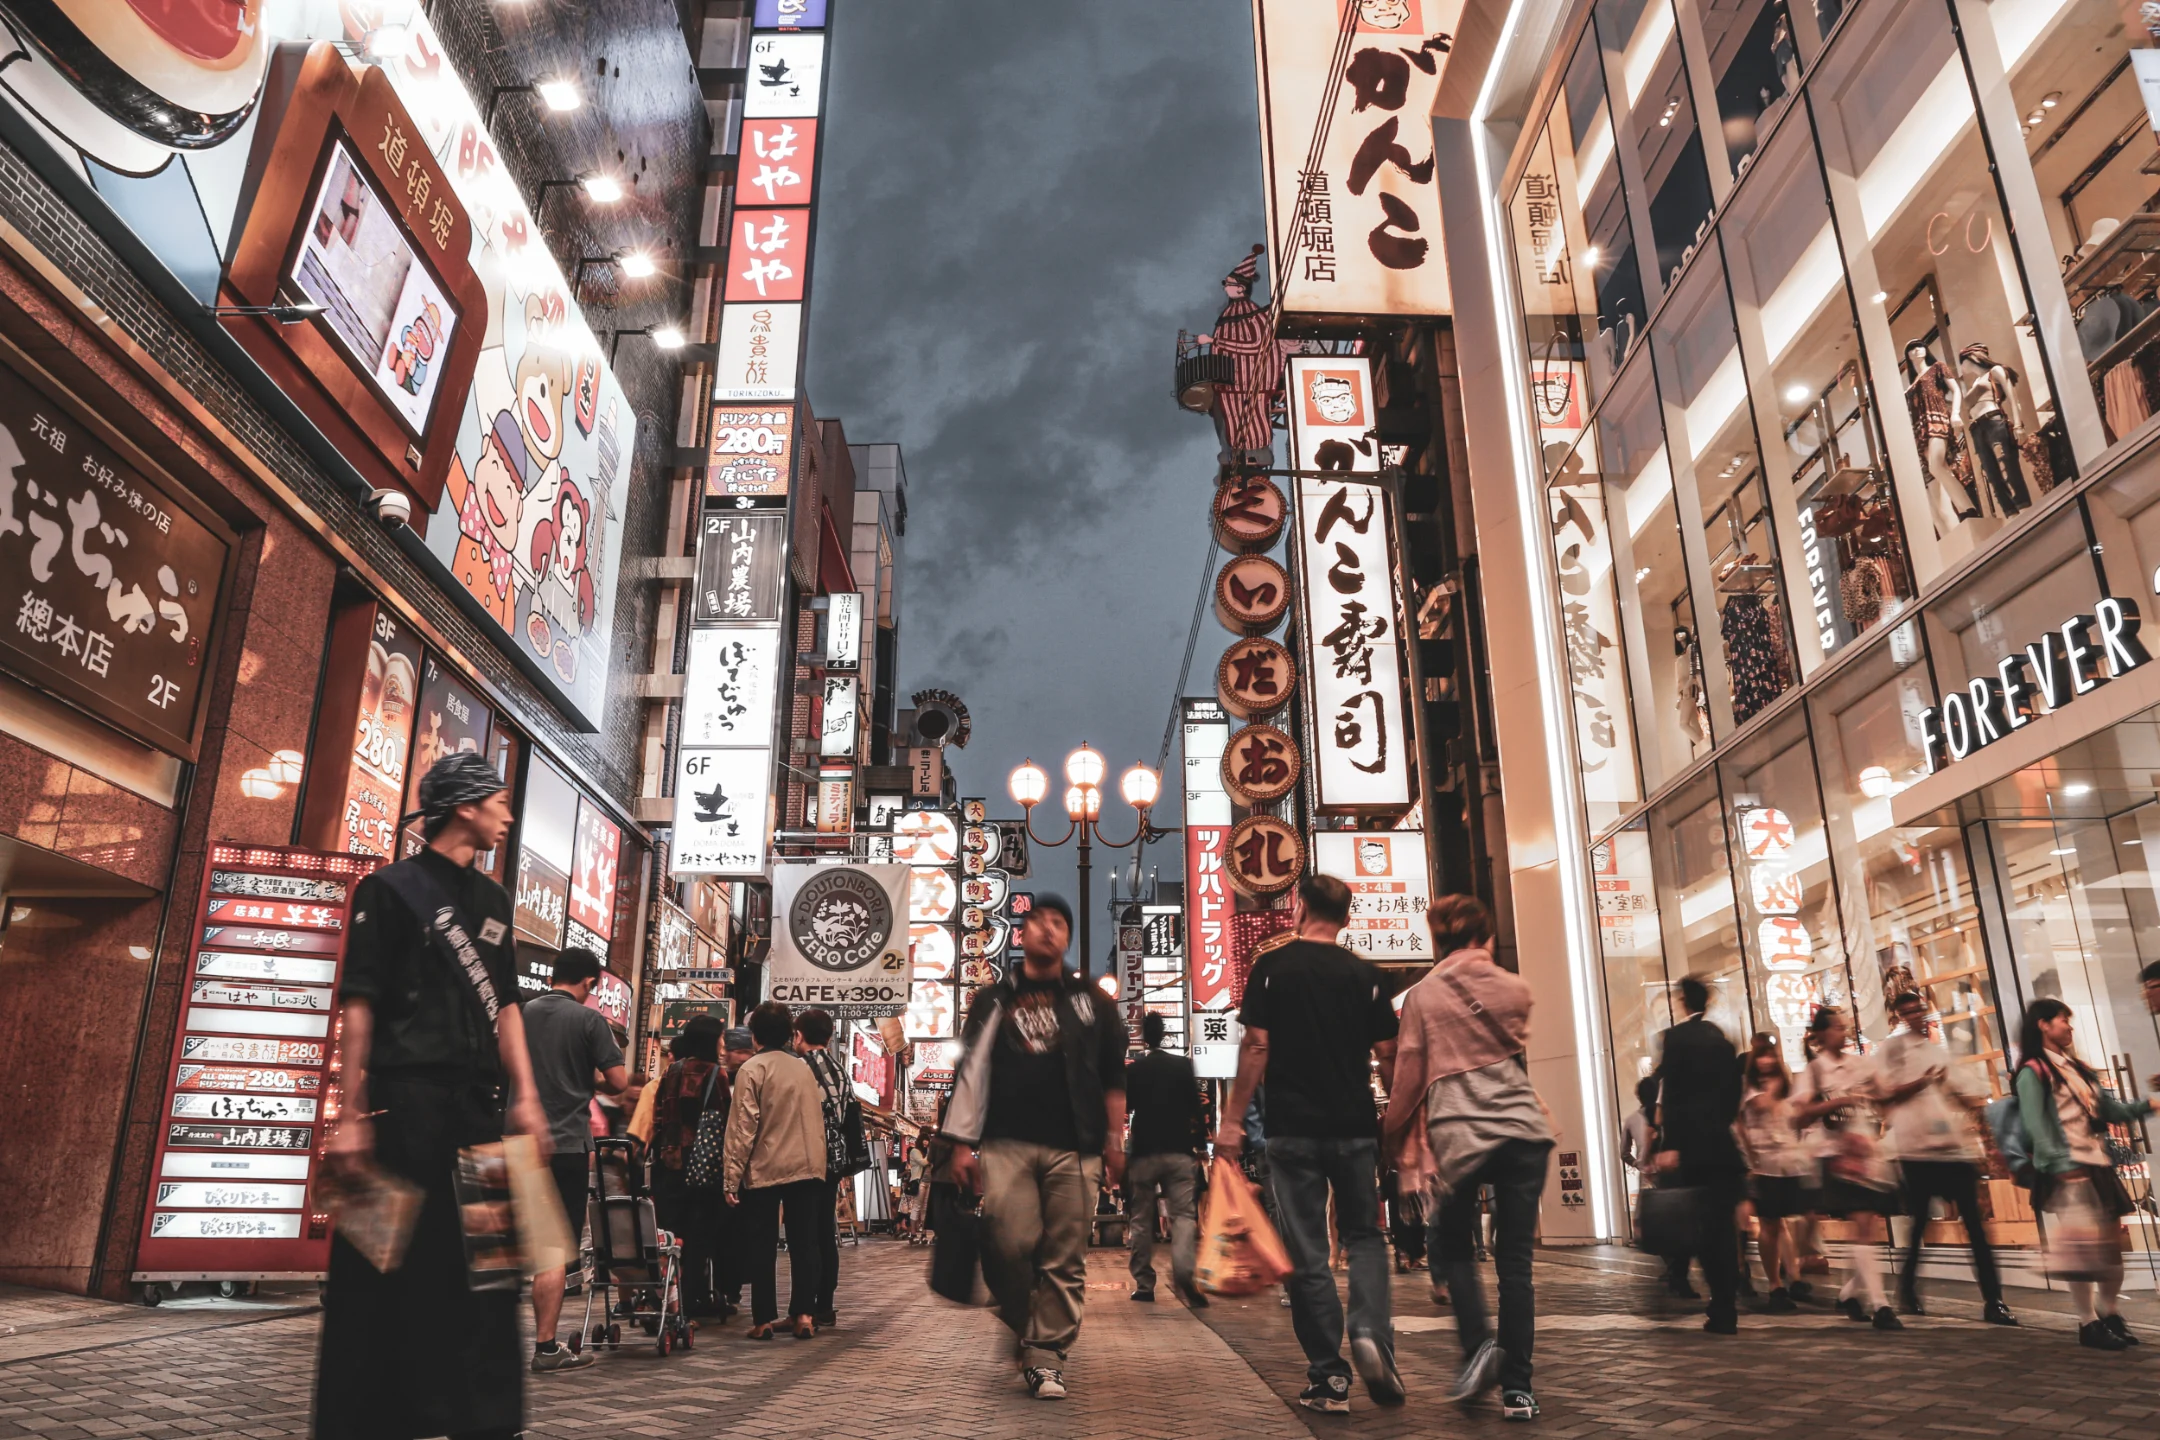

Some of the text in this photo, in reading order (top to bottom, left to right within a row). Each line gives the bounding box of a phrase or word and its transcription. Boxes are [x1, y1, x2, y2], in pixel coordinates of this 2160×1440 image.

[755, 40, 776, 53] 6F
[752, 123, 801, 200] はや
[378, 112, 455, 251] 道頓堀
[1297, 170, 1336, 283] 道頓堀店
[742, 215, 793, 296] はや
[745, 309, 772, 385] 鳥貴族
[30, 413, 67, 454] 元祖
[715, 427, 787, 455] 280円
[82, 454, 172, 534] お好み焼の店
[736, 496, 755, 509] 3F
[707, 518, 731, 534] 2F
[724, 519, 757, 617] 山内農場
[1797, 506, 1836, 651] FOREVER
[375, 612, 396, 643] 3F
[427, 660, 438, 682] 7F
[147, 674, 181, 709] 2F
[1917, 597, 2137, 775] FOREVER
[445, 693, 471, 726] 居食屋
[1186, 725, 1200, 734] 5F
[686, 756, 711, 775] 6F
[1187, 759, 1200, 767] 4F
[1187, 793, 1201, 801] 3F
[520, 851, 532, 873] 2F
[517, 874, 563, 930] 山内農場
[798, 875, 885, 913] DOUTONBORI
[1197, 830, 1227, 986] ツルハドラッグ
[798, 931, 883, 966] ZERO Cafe
[883, 953, 905, 970] 2F
[772, 985, 835, 1001] CAFE
[1204, 1018, 1227, 1041] 薬
[200, 1072, 247, 1081] ALL DRINK
[171, 1126, 189, 1136] 2F
[222, 1127, 292, 1147] 山内農場
[205, 1187, 280, 1206] びっくりドンキー
[200, 1217, 276, 1236] びっくりドンキー
